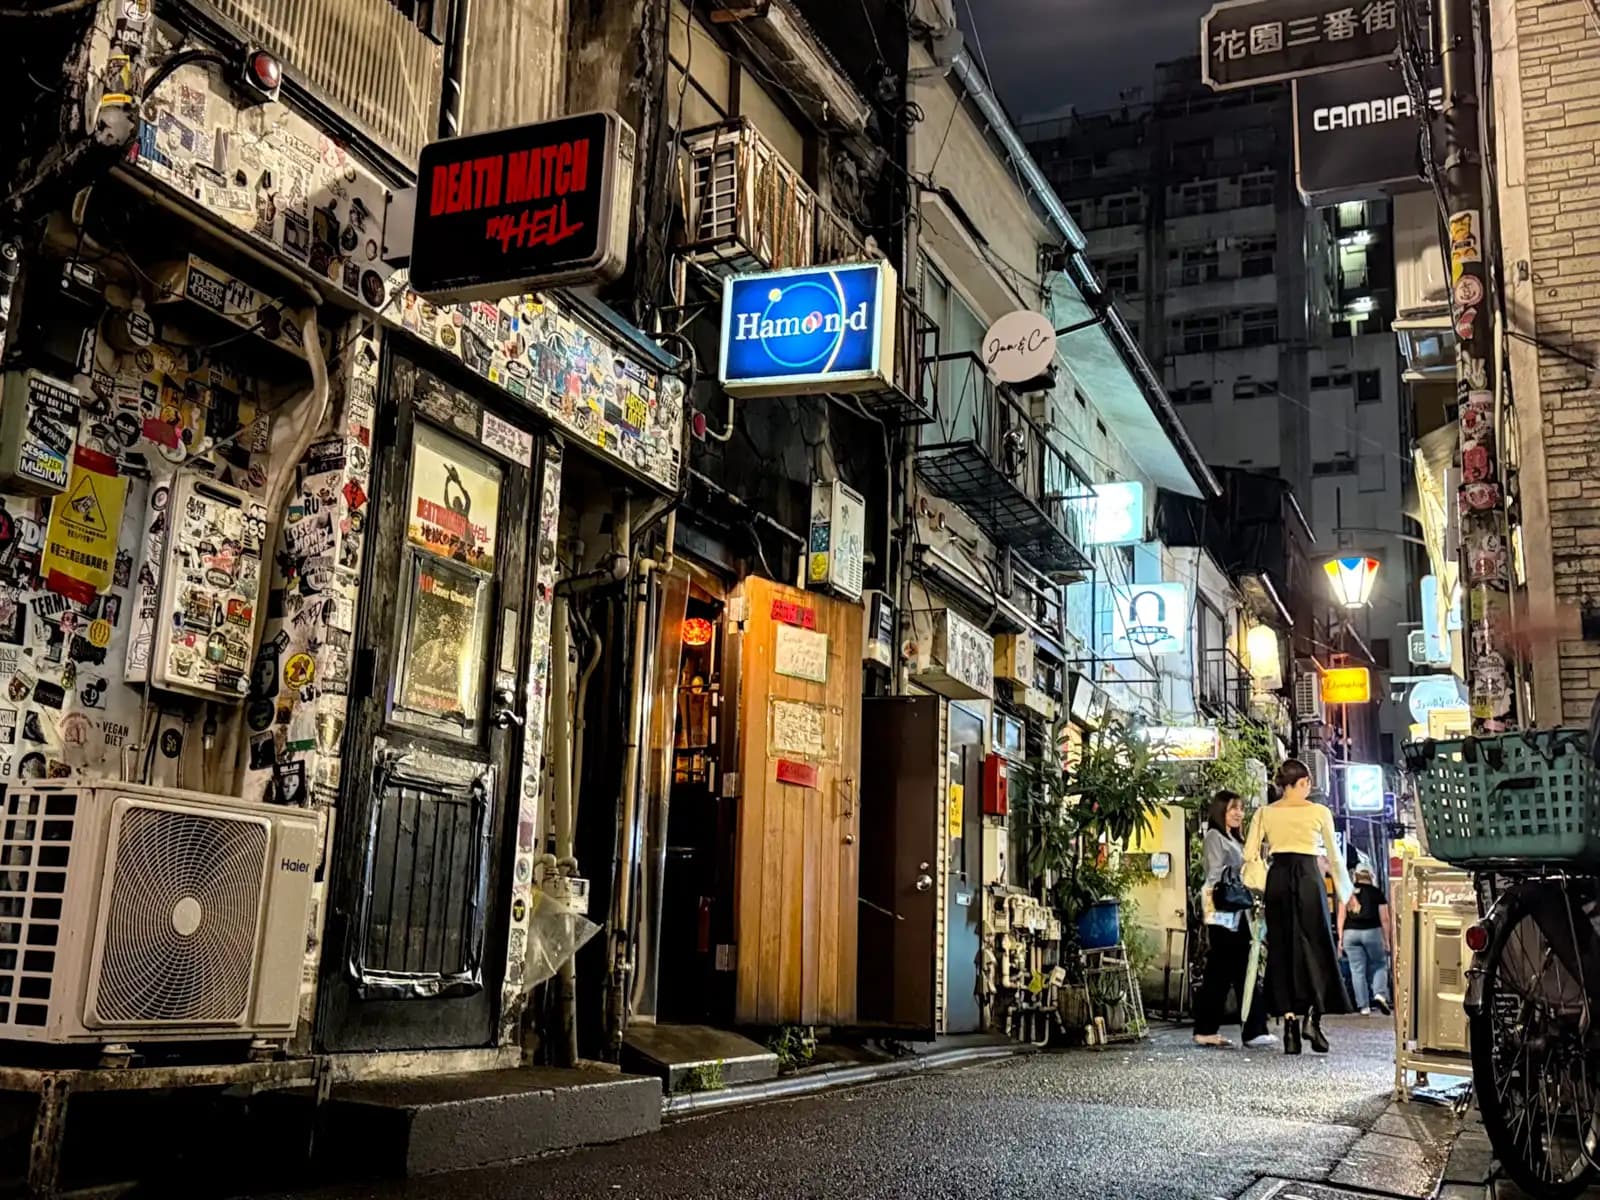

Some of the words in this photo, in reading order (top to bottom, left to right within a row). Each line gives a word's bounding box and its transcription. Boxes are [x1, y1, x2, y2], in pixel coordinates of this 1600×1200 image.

[1213, 2, 1397, 62] 花園三番街
[1314, 88, 1442, 131] CAMBIAE
[430, 156, 502, 216] DEATH
[506, 140, 589, 203] MATCH
[103, 721, 129, 737] VEGAN
[105, 734, 124, 747] DIET
[281, 858, 310, 873] Haier
